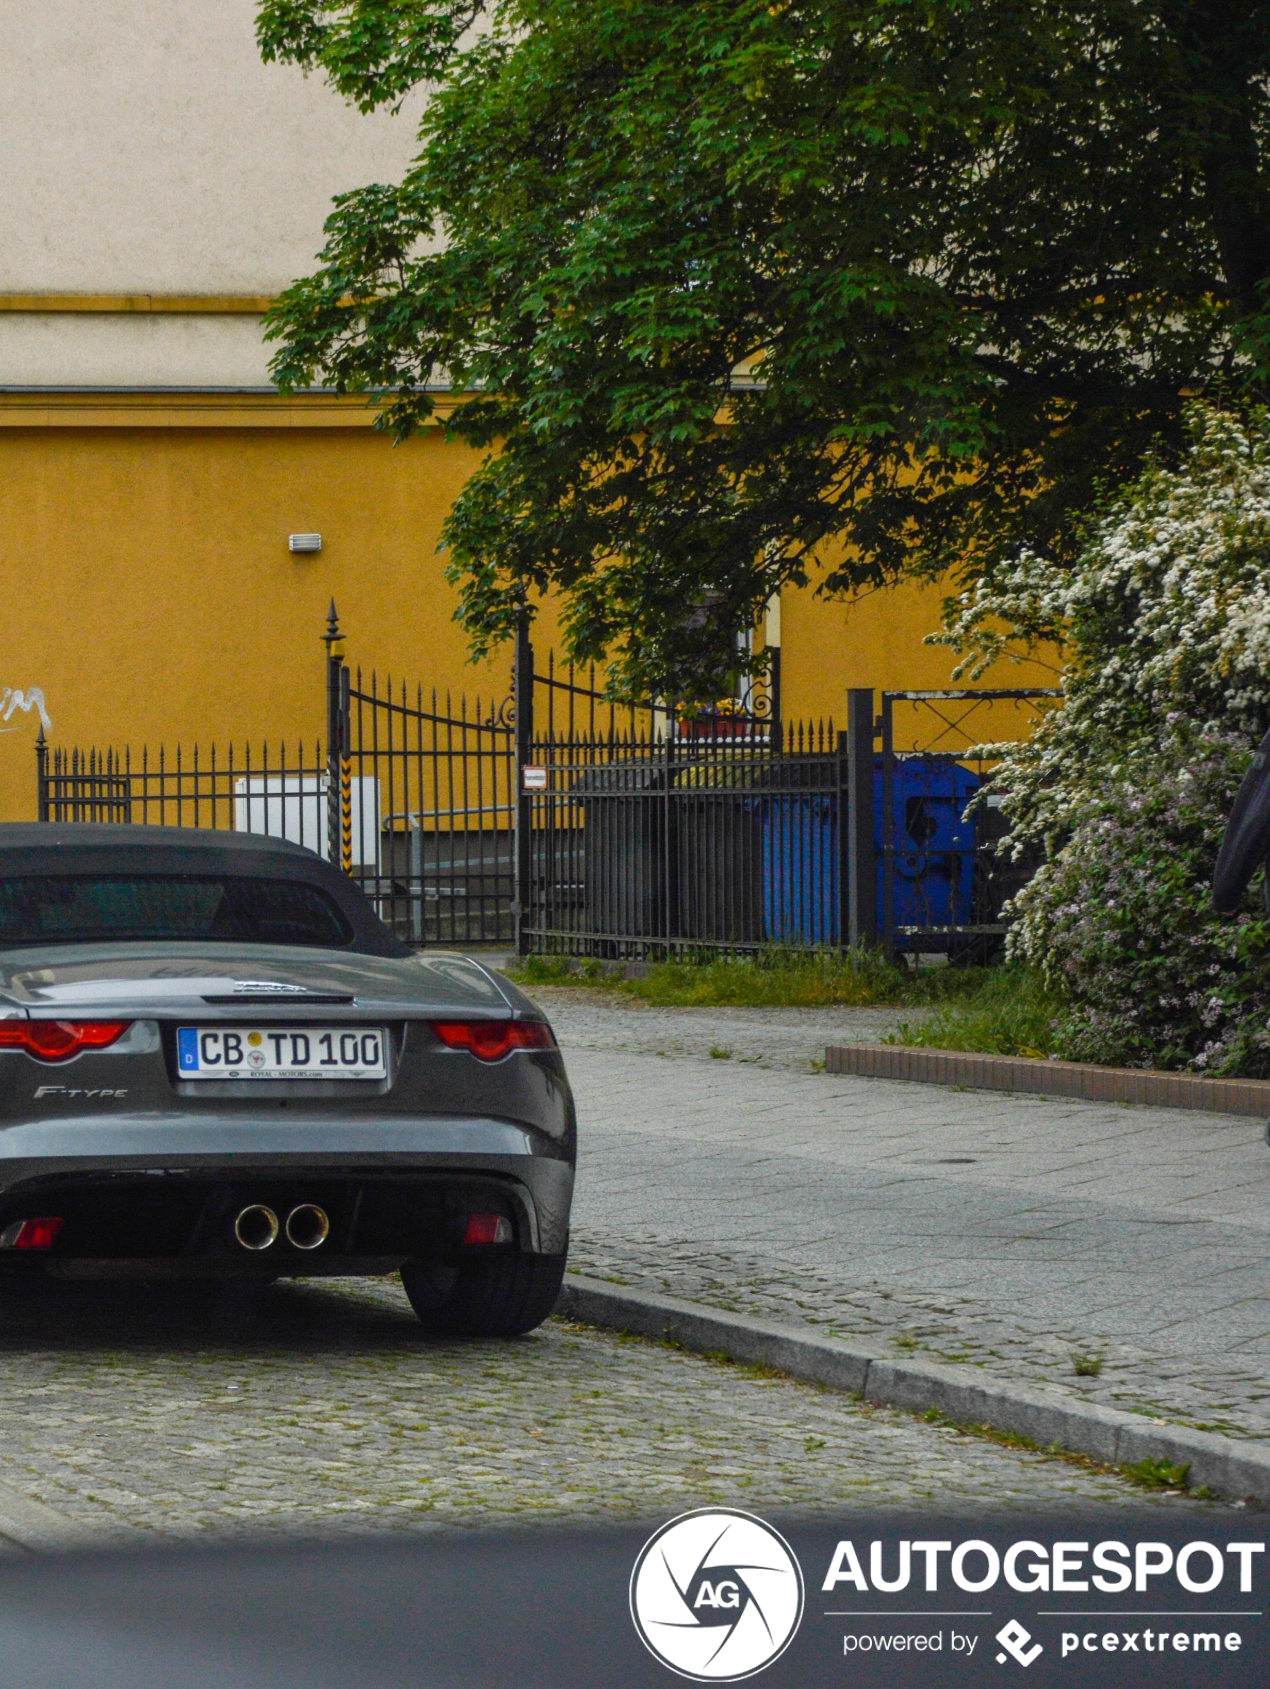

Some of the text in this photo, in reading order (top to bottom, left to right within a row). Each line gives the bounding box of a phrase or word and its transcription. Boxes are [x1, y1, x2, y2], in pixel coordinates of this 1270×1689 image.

[185, 1033, 379, 1066] D CB TD 100
[250, 1070, 272, 1078] ROYAL
[279, 1070, 323, 1078] MOTORS.com
[33, 1085, 128, 1098] F-TYPE
